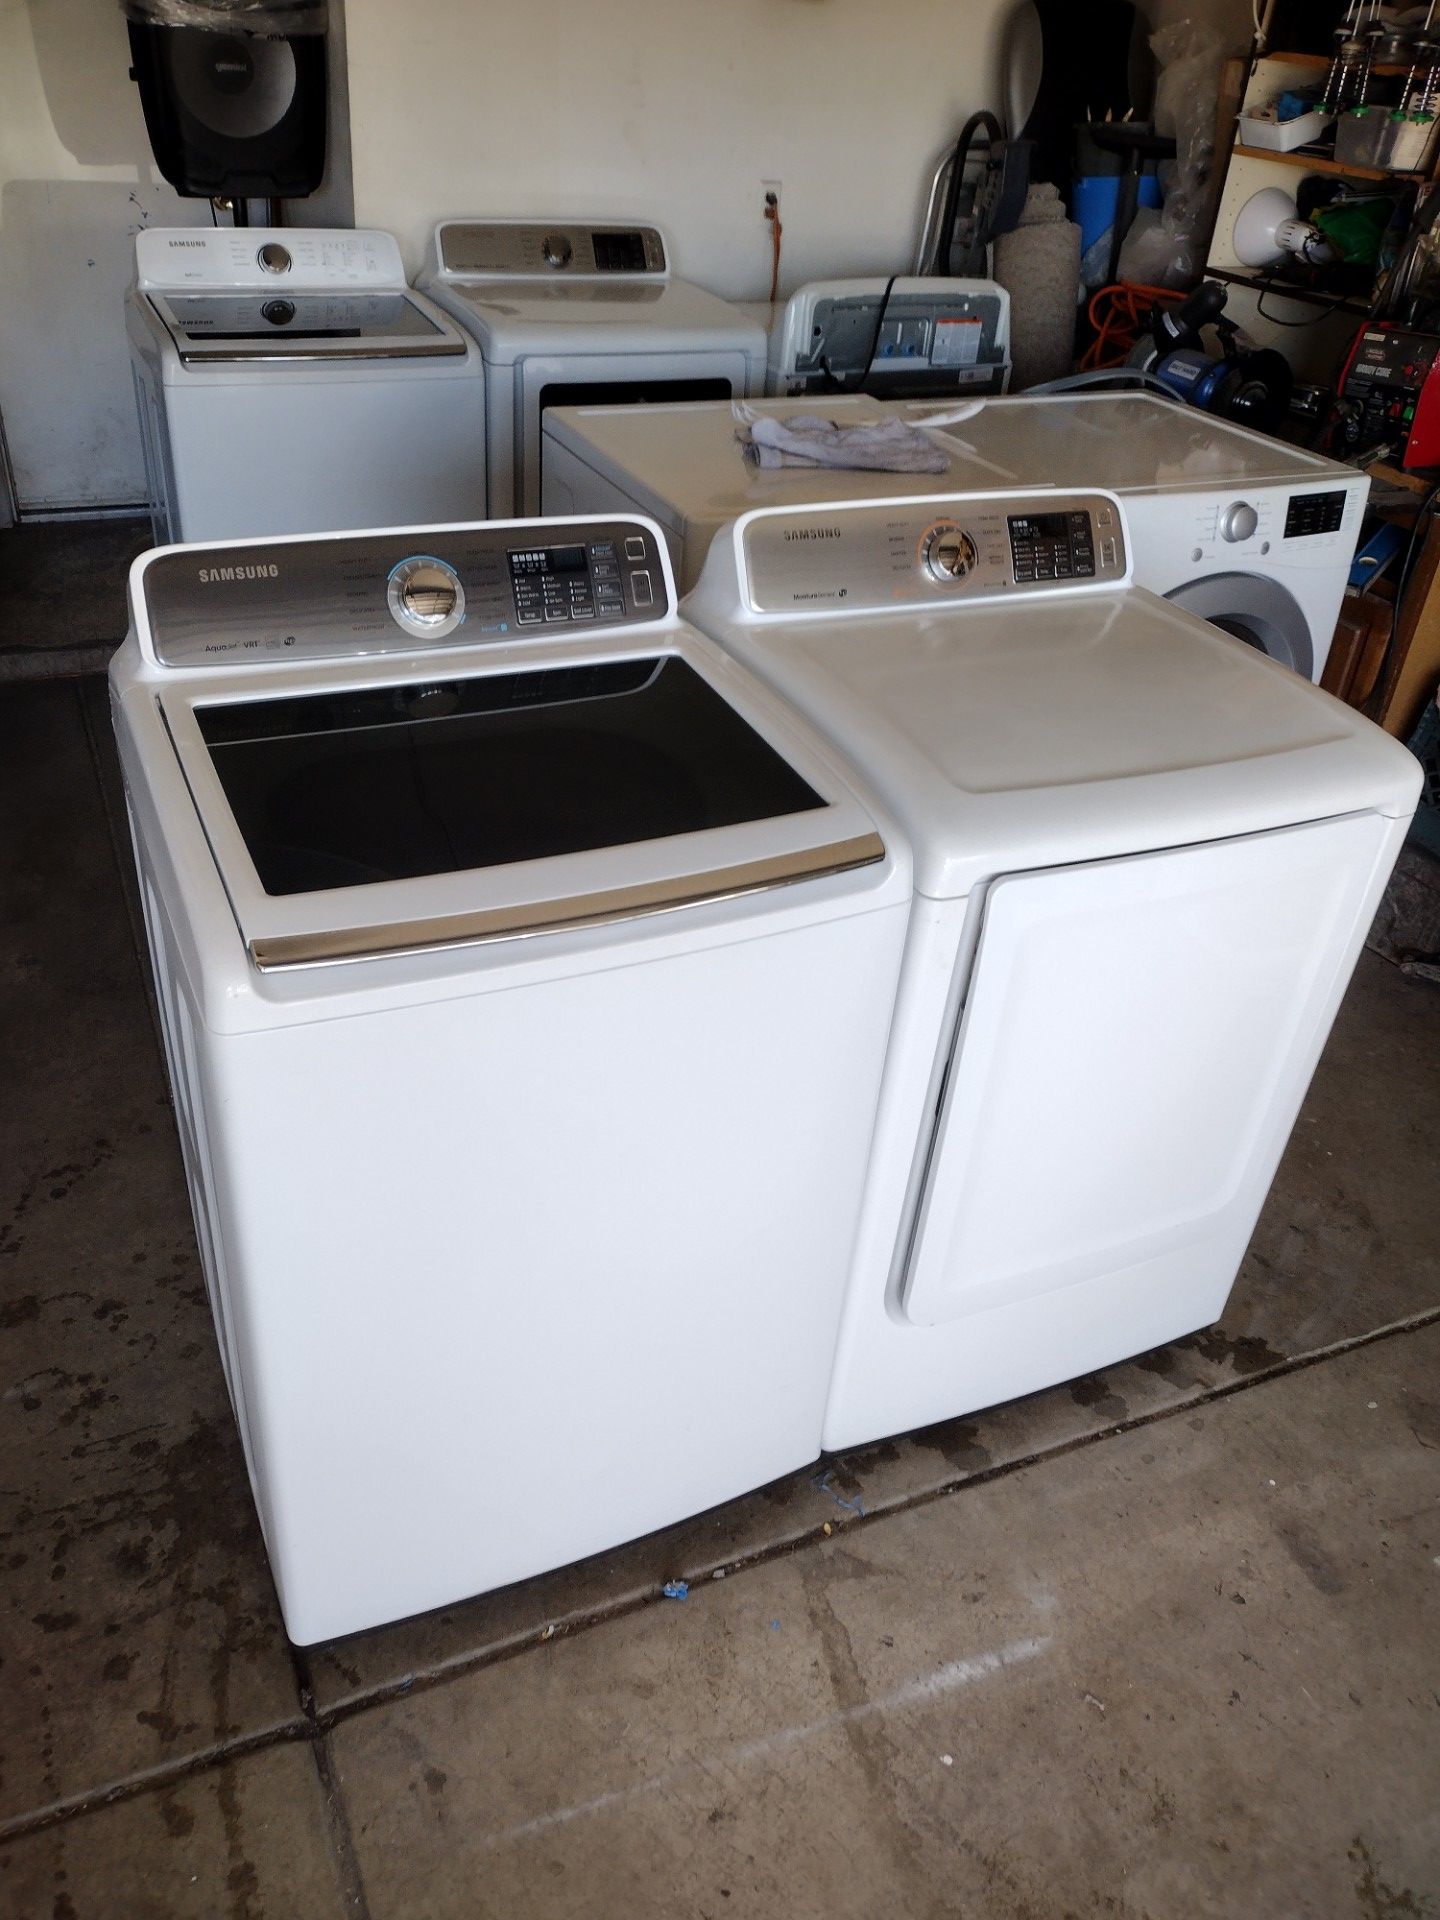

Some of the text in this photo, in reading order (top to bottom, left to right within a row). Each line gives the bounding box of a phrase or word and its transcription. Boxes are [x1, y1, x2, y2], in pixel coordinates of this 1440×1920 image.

[169, 240, 206, 248] SAMSUNG
[784, 527, 841, 541] SAMSUNG
[199, 564, 279, 583] SAMSUNG
